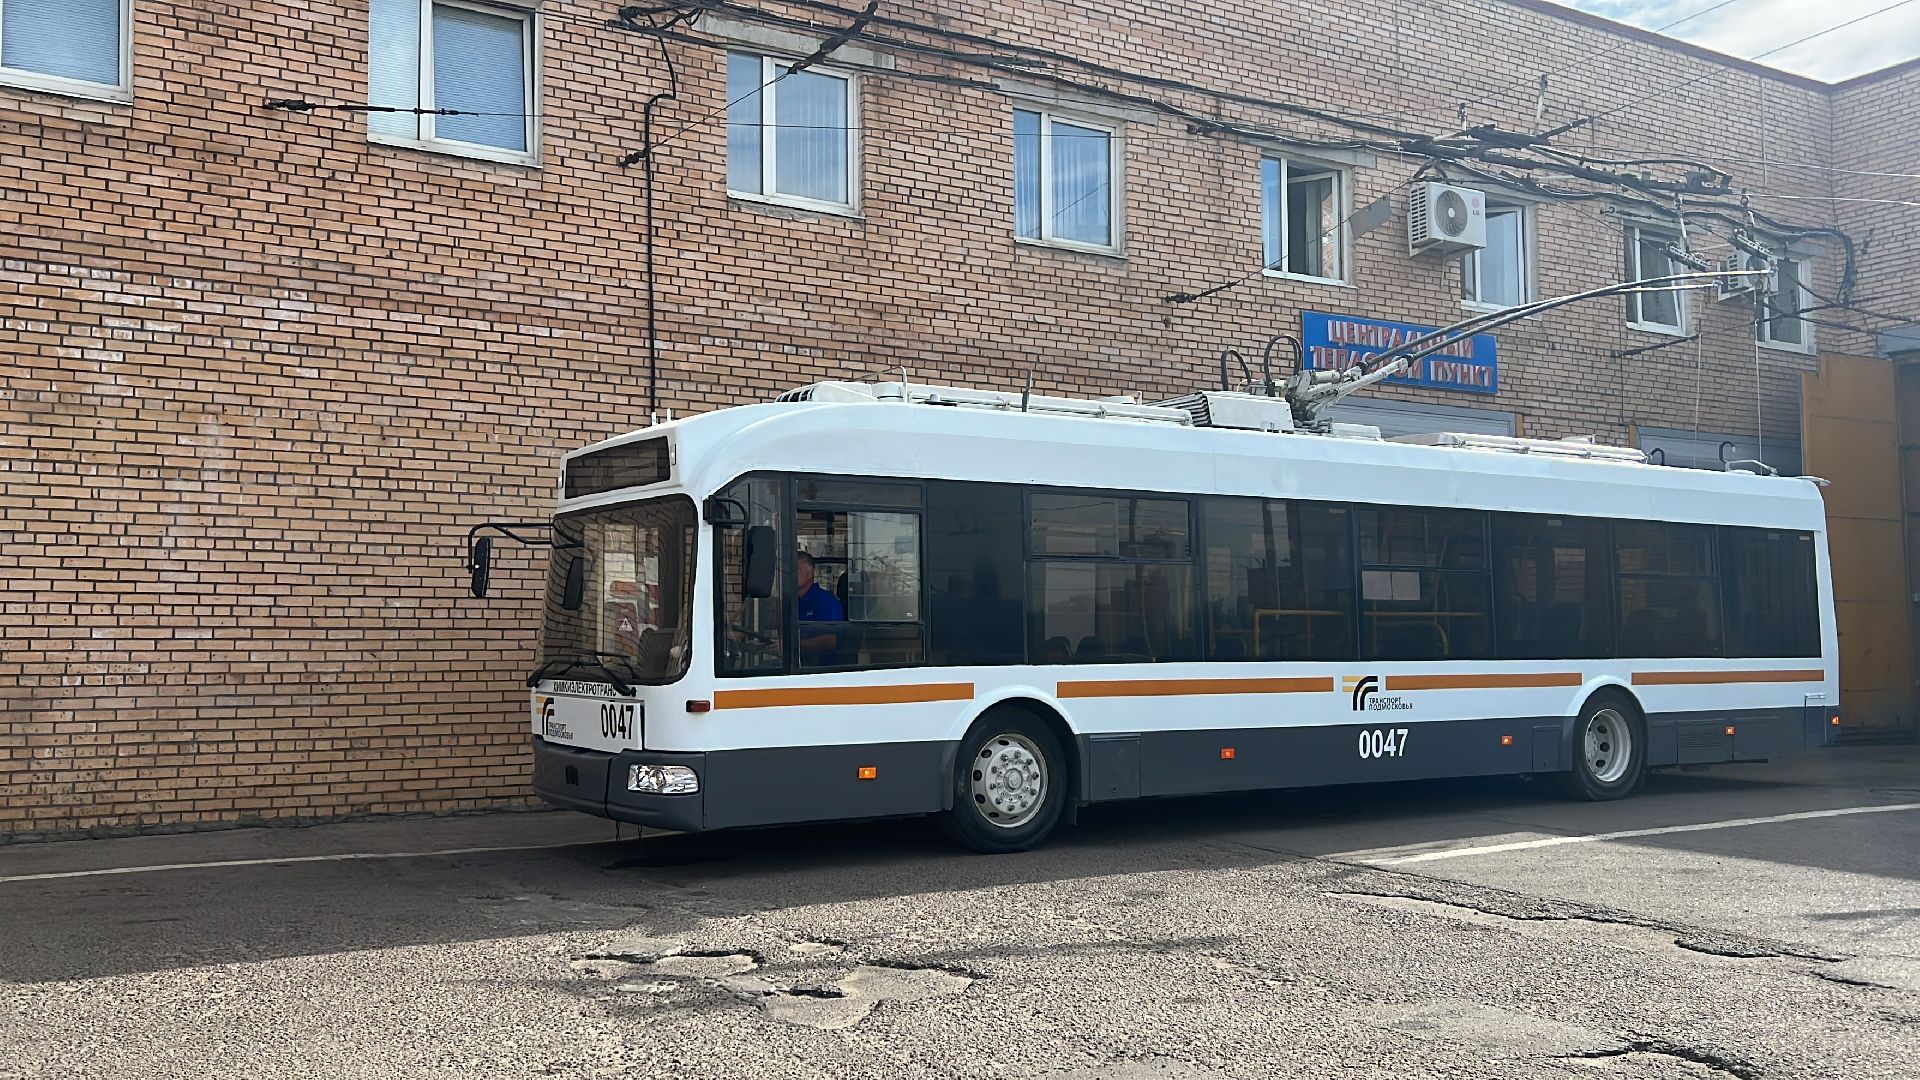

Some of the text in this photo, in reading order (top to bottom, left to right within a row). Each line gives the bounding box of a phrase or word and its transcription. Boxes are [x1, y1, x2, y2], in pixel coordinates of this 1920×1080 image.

[1430, 360, 1494, 387] ПУНКТ
[1368, 696, 1402, 704] ТРАНСПОРТ
[1368, 702, 1413, 711] ПОДМОСКОВЬЯ
[601, 703, 634, 740] 0047
[1358, 728, 1409, 759] 0047
